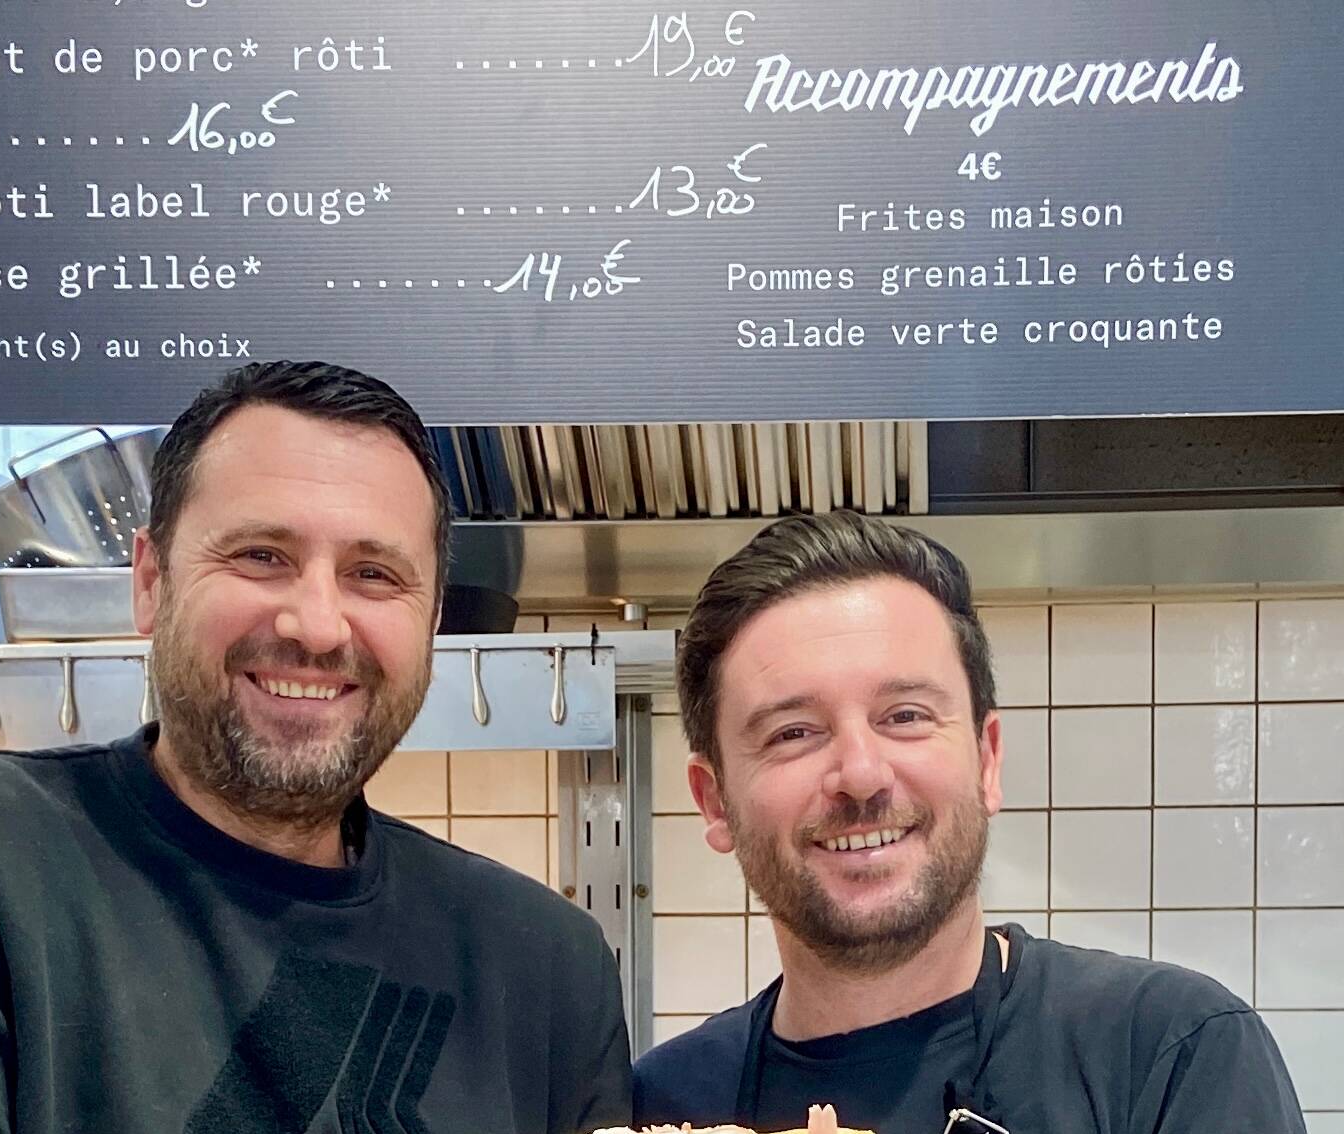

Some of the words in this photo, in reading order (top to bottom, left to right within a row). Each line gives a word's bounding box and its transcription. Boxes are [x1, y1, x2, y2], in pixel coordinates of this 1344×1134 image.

[54, 38, 103, 73] de
[293, 36, 392, 72] rôti
[743, 41, 1244, 136] Accompagnements
[957, 151, 1002, 181] 4€
[86, 183, 210, 218] label
[838, 202, 965, 232] Frites
[991, 198, 1123, 229] maison
[728, 263, 854, 291] Pommes
[880, 256, 1077, 296] grenaille
[1105, 252, 1234, 284] rôties
[105, 339, 140, 358] au
[160, 332, 251, 358] choix
[737, 317, 865, 348] Salade
[891, 318, 998, 345] verte
[1024, 312, 1222, 349] croquante
